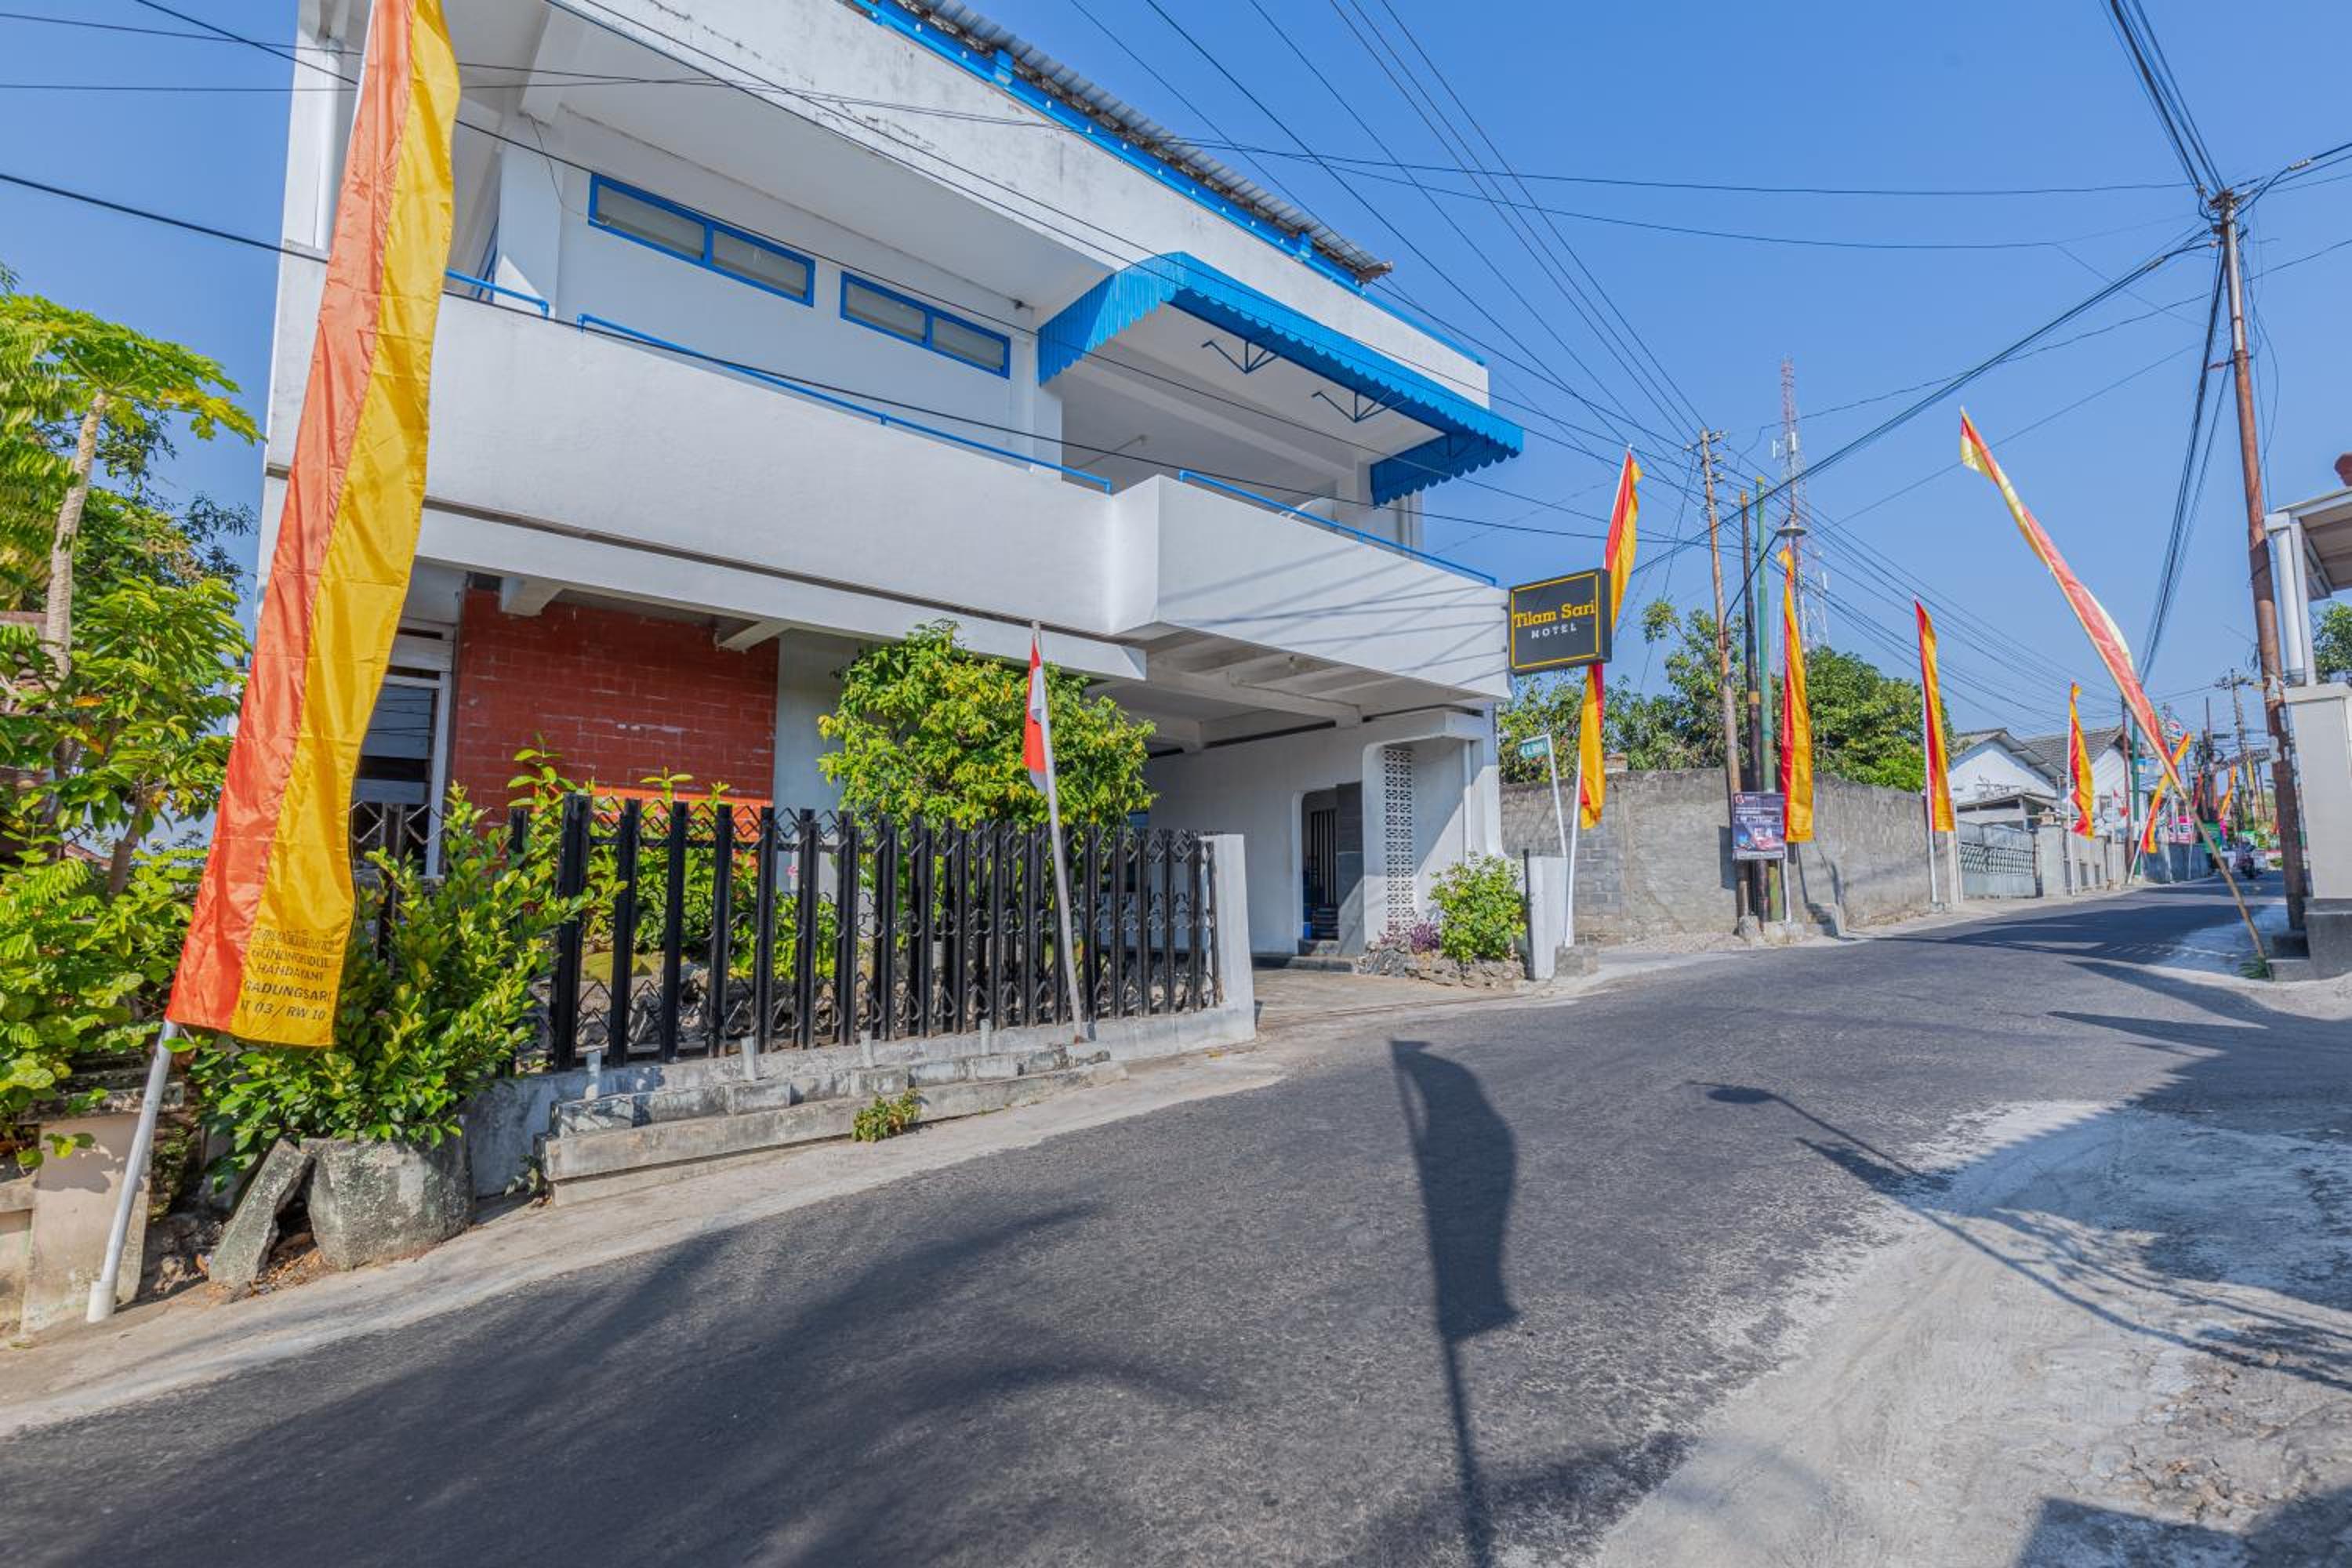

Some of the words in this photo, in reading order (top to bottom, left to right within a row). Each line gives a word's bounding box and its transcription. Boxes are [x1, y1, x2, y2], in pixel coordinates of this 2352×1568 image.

[1513, 611, 1556, 628] Tilam
[1561, 600, 1596, 619] Sari
[1531, 622, 1577, 639] HOTEL
[254, 1000, 274, 1014] 03
[285, 1006, 309, 1018] RW
[313, 1009, 327, 1021] 10
